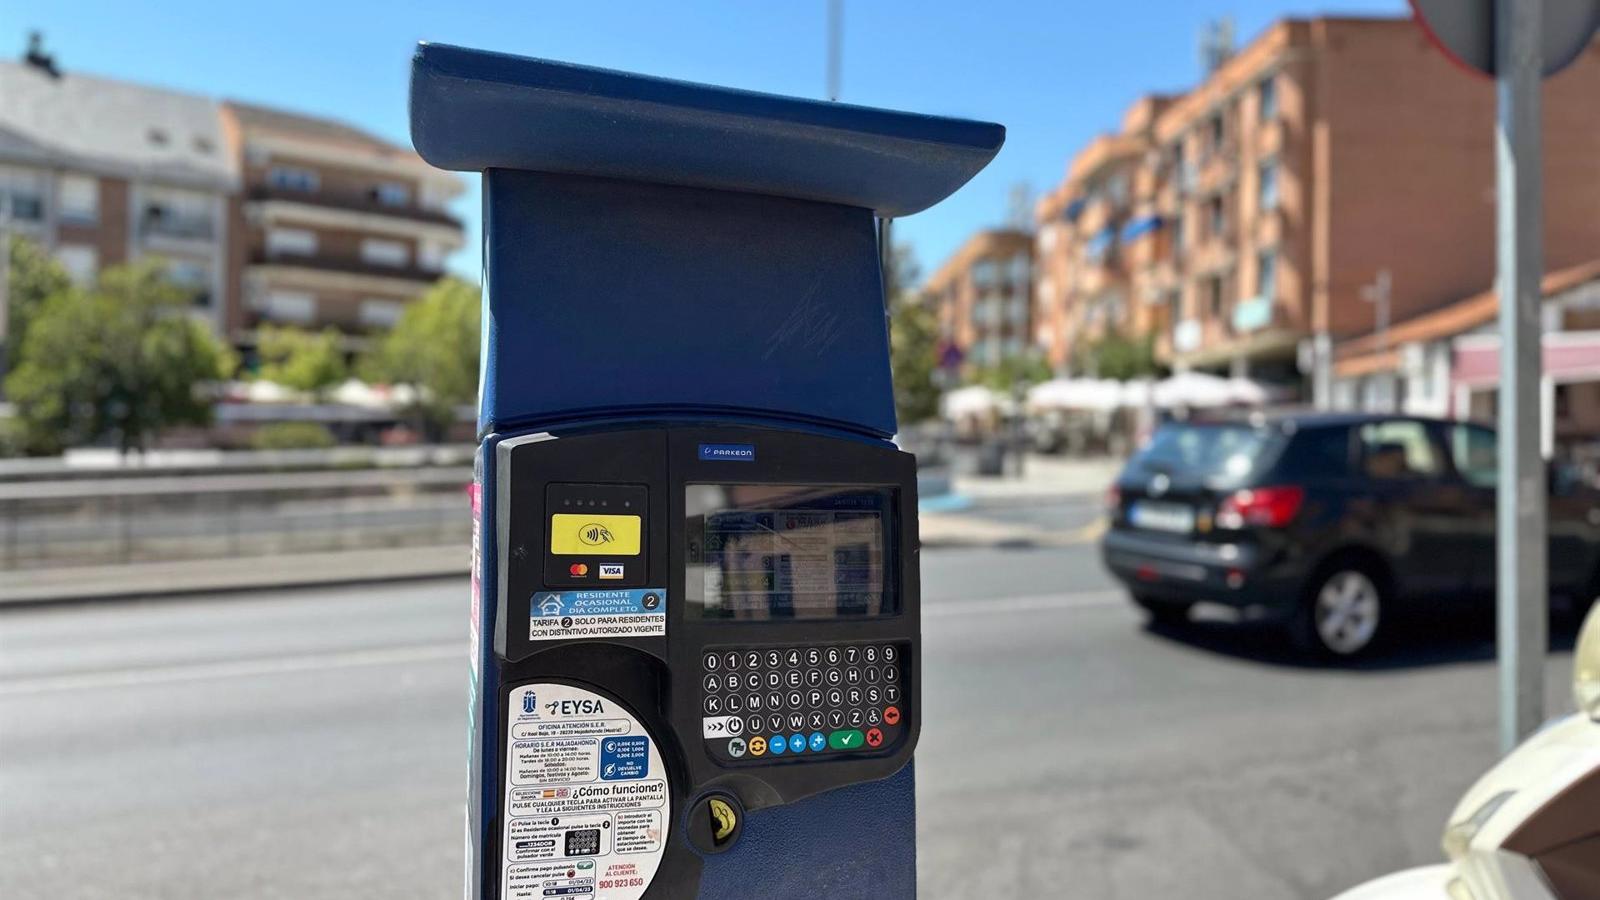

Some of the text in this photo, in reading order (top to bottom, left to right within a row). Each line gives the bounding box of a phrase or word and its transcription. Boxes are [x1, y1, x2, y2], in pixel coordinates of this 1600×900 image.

[646, 595, 655, 607] 2
[532, 618, 559, 627] TARIFA
[532, 629, 548, 637] CON
[549, 627, 588, 636] DISTINTIVO
[589, 626, 632, 634] AUTORIZADO
[708, 648, 893, 668] 0 1 2 3 4 5 6 7 8 9
[708, 669, 893, 689] A B C D E F G H I J
[562, 700, 604, 714] EYSA
[709, 689, 895, 710] K L M N O P Q R S T
[752, 713, 859, 729] U V W X Y Z
[572, 783, 663, 799] ¿Cómo funciona?
